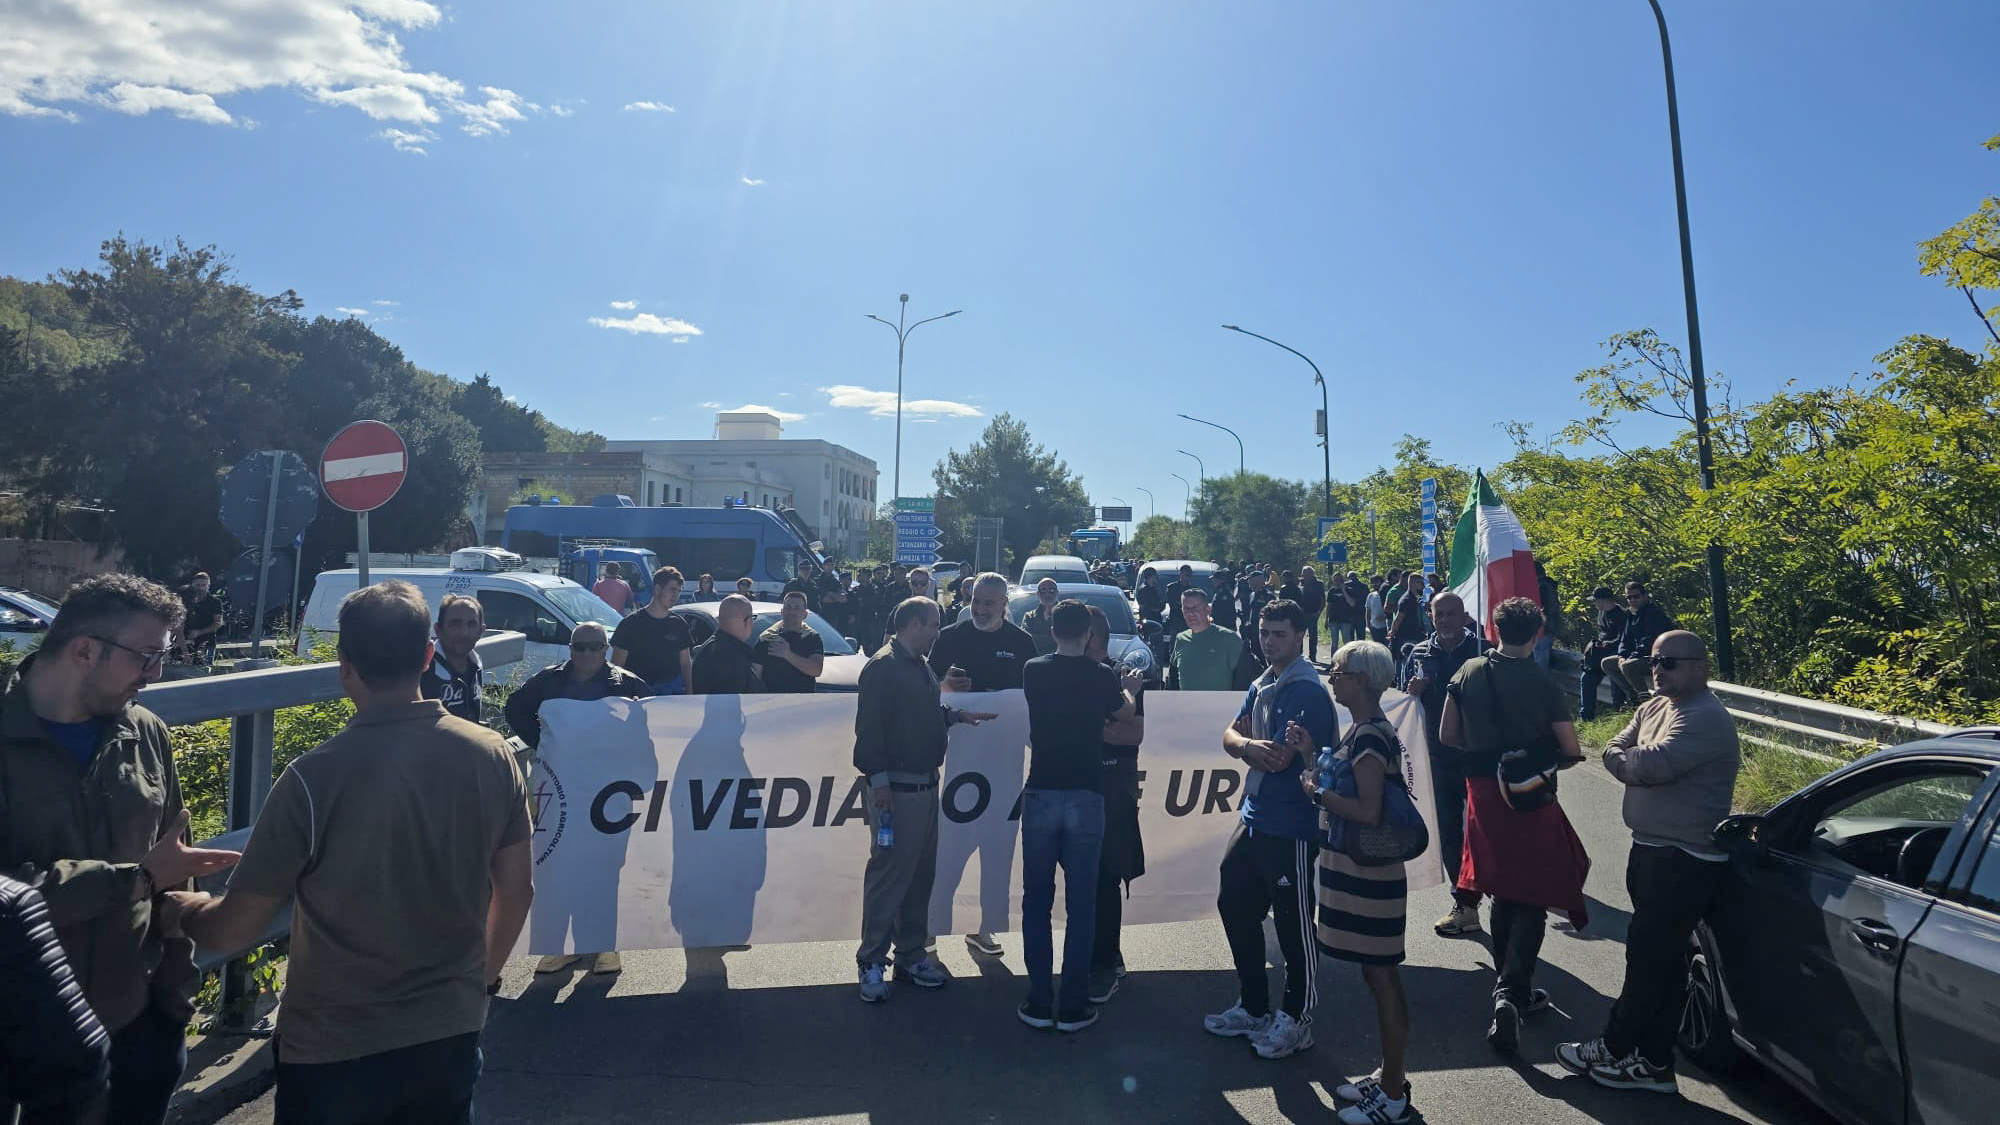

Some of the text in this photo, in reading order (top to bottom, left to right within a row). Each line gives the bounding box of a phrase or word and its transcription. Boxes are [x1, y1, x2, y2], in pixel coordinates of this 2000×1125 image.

[590, 780, 668, 834] CI
[688, 771, 991, 831] VEDIAO
[1165, 769, 1246, 817] UR
[535, 810, 567, 866] AGRICOLTURA
